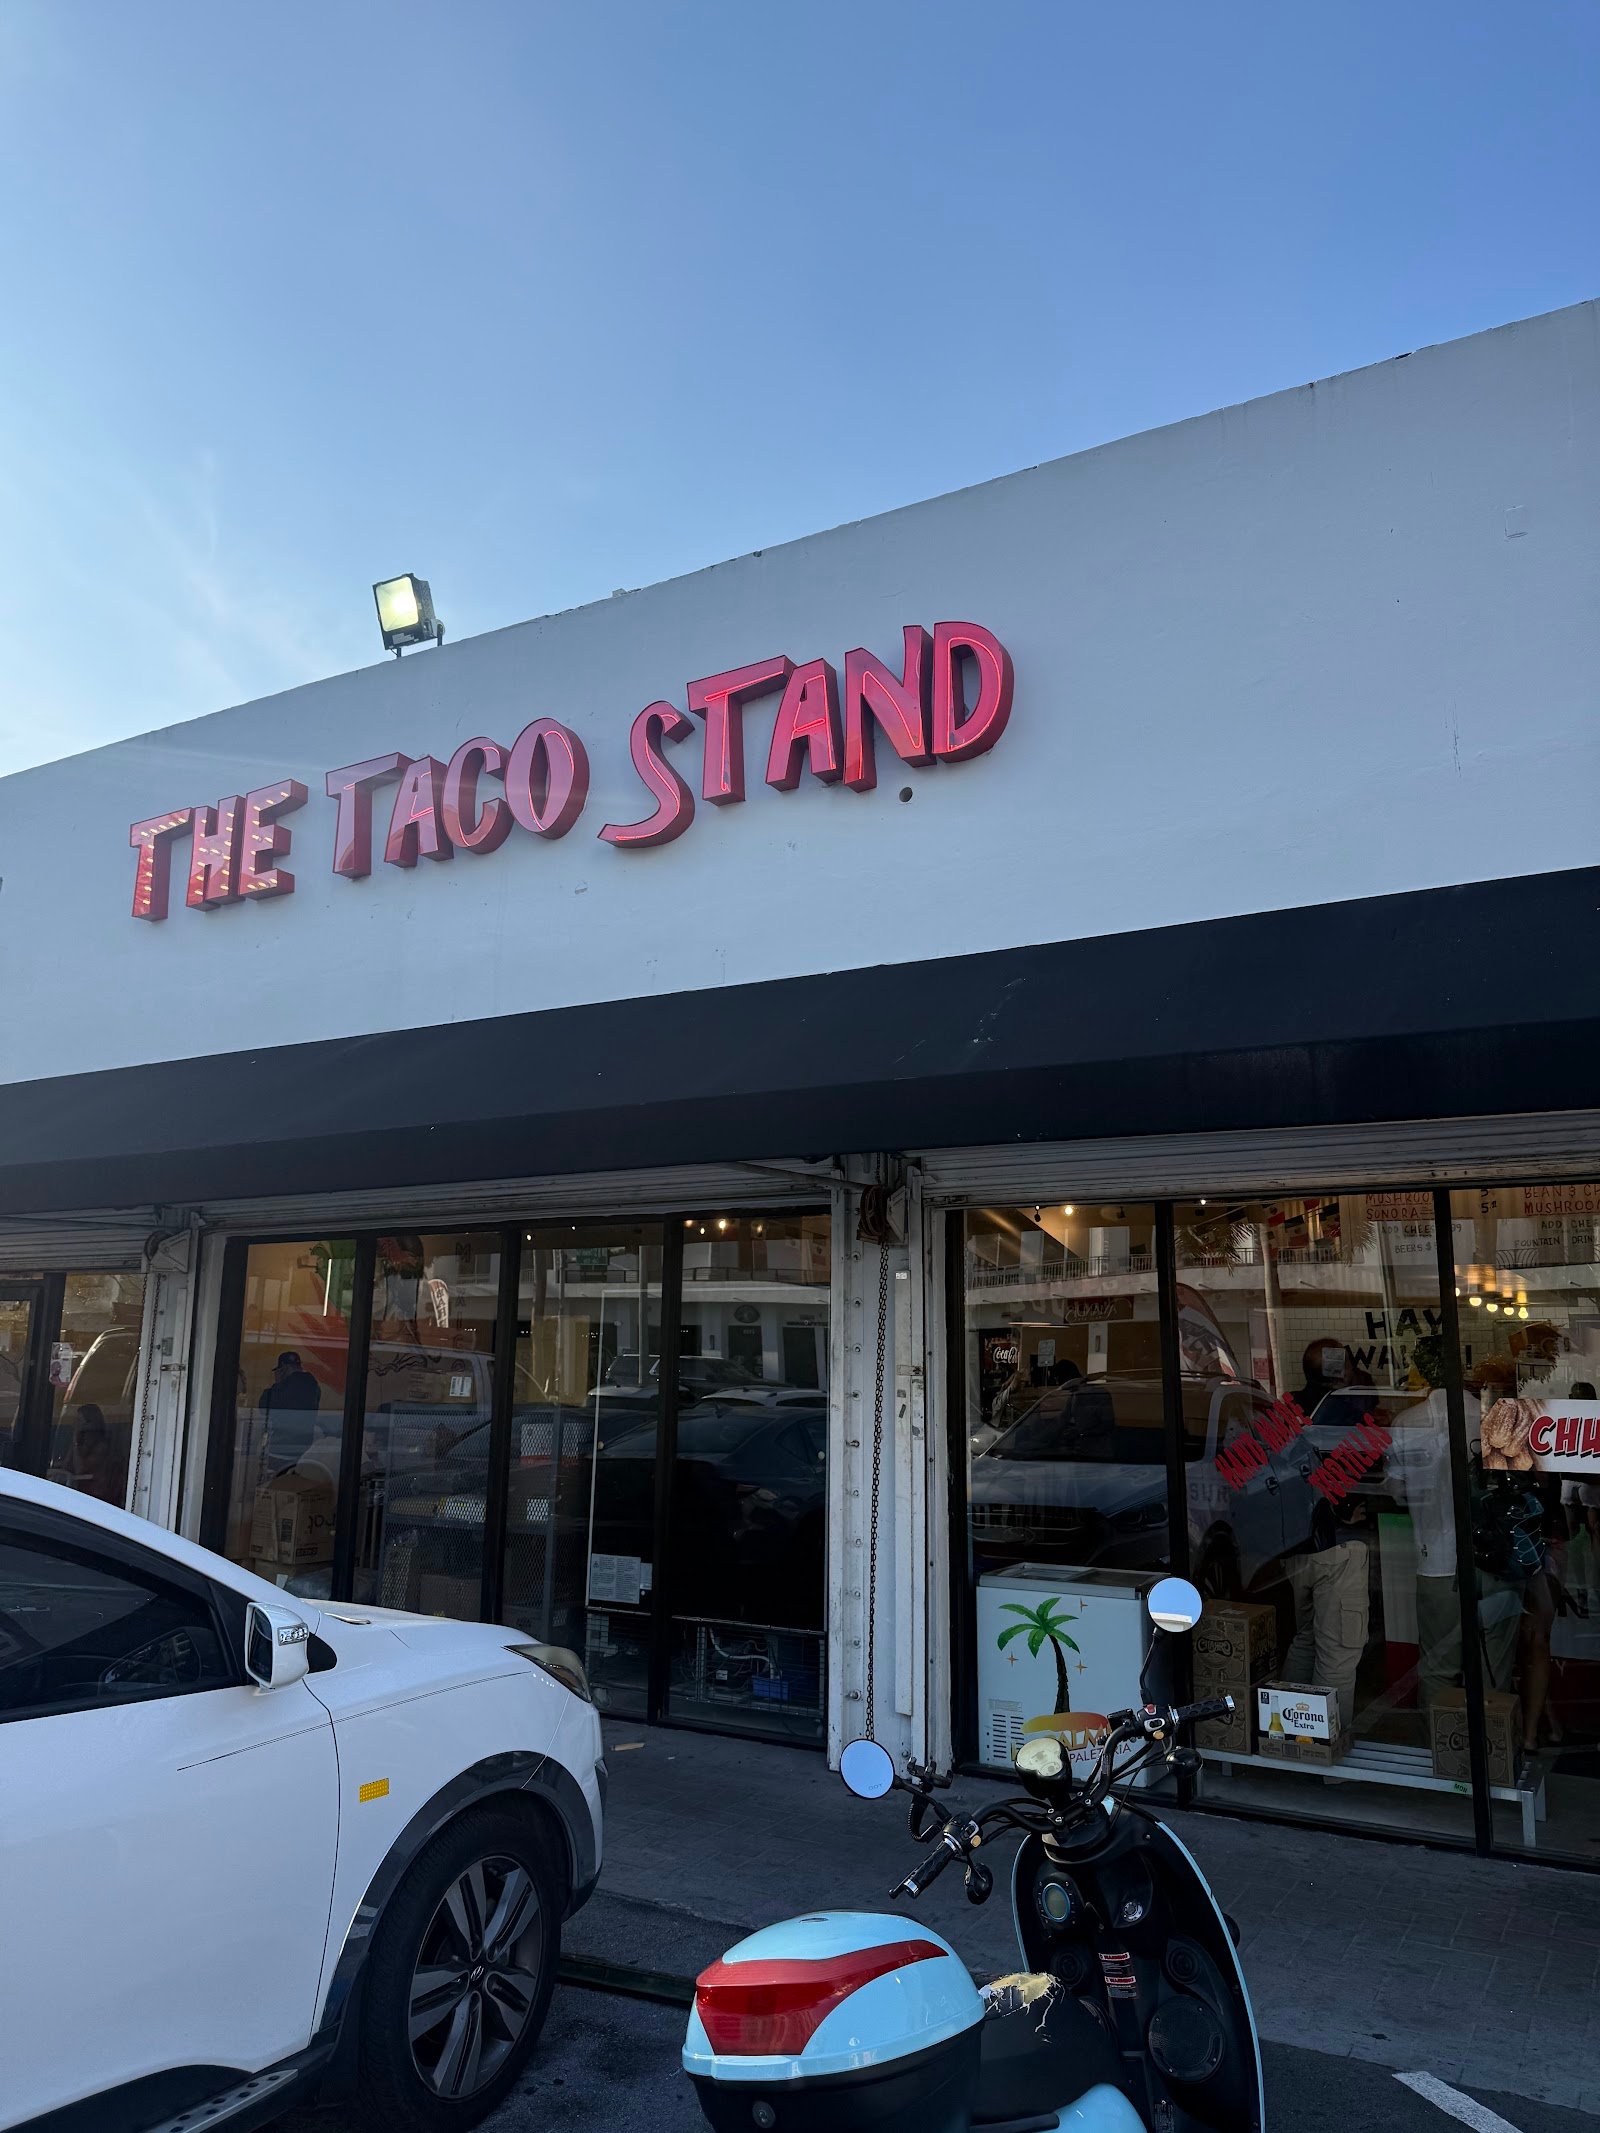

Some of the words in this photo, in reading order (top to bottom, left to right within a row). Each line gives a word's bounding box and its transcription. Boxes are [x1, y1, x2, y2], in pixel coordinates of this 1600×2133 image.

[130, 779, 308, 922] THE
[326, 717, 590, 879] TACO
[598, 620, 1014, 850] STAND
[1366, 1191, 1434, 1205] MUSHROO
[1514, 1236, 1561, 1248] FOUNTAIN
[1214, 1433, 1269, 1492] HAND
[1253, 1392, 1313, 1454] MADE
[1307, 1412, 1393, 1505] TORTILLAS
[1282, 1707, 1324, 1723] Corona
[1294, 1720, 1315, 1730] Extra
